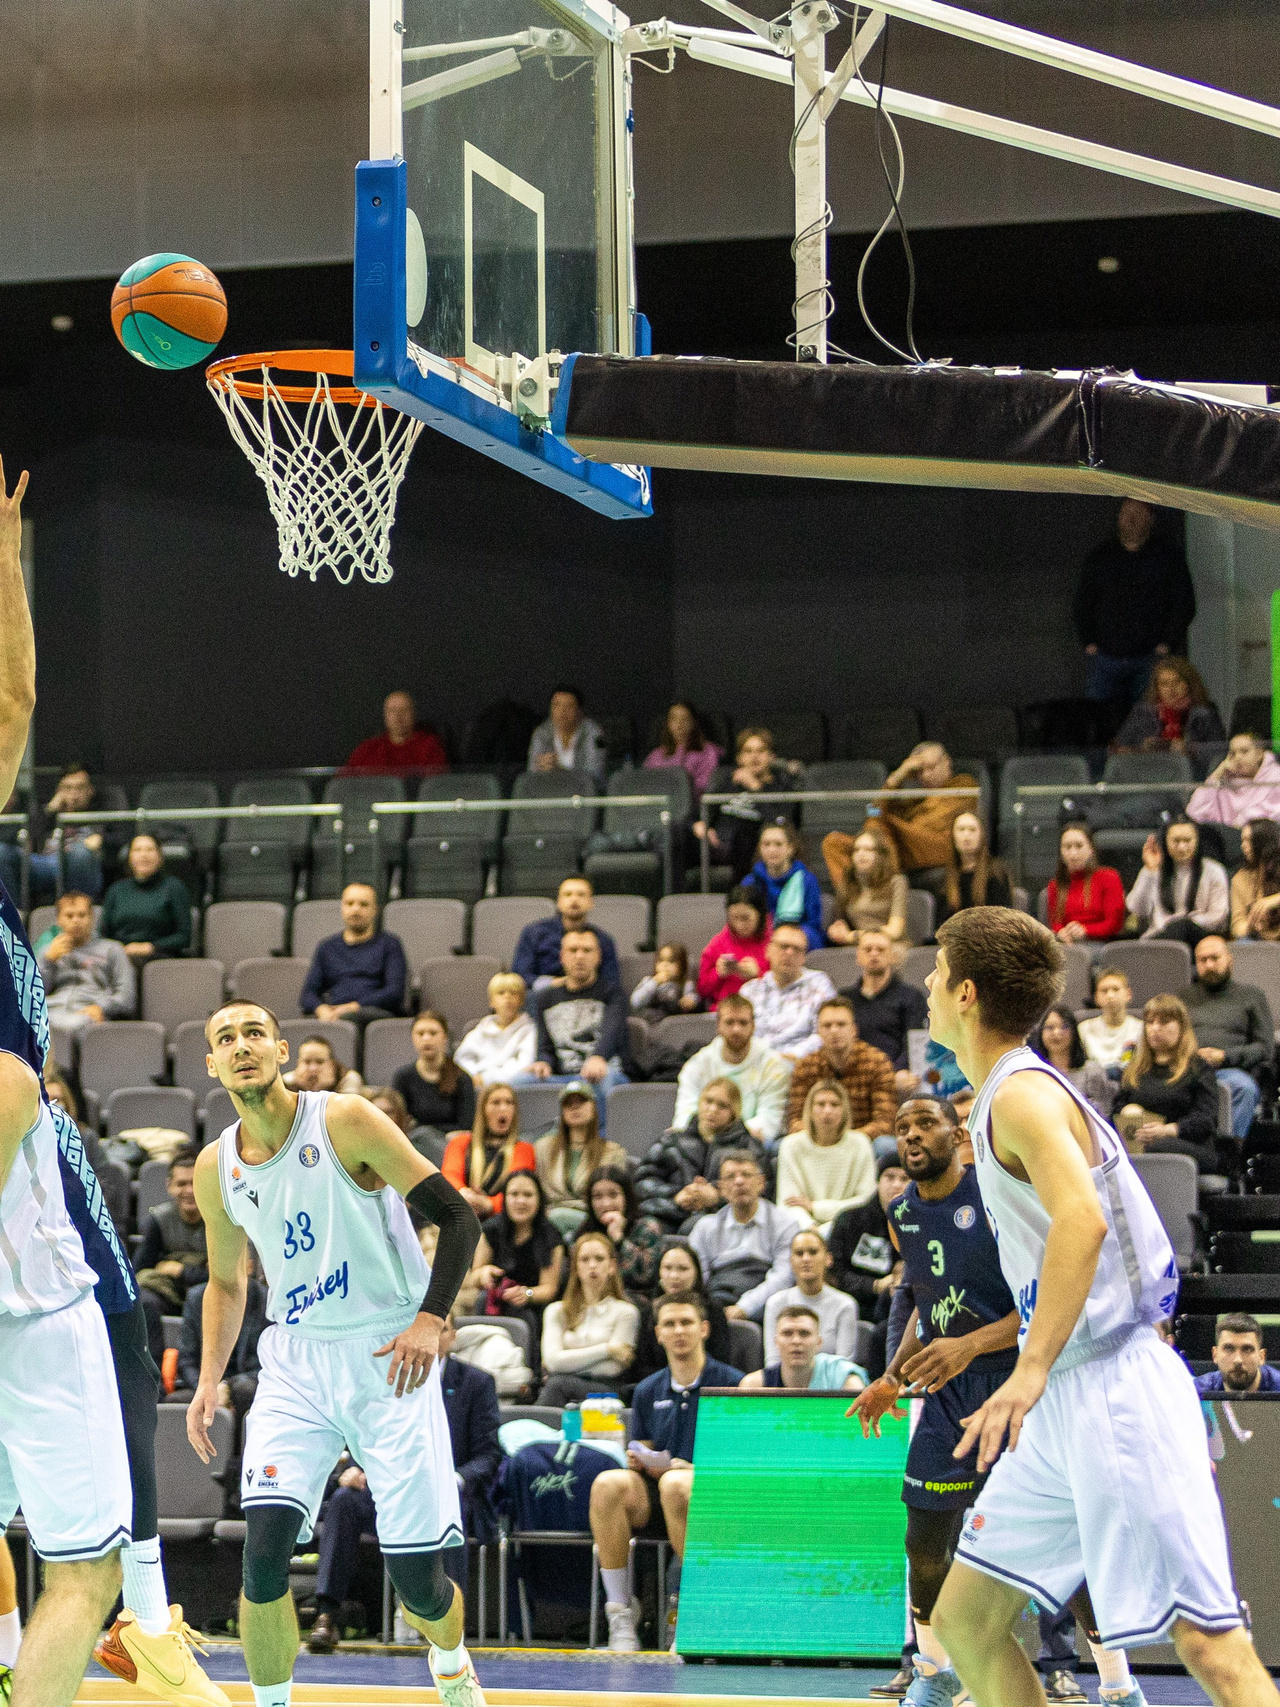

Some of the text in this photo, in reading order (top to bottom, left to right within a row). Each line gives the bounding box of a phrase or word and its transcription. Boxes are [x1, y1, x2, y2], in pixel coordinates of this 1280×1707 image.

[284, 1211, 316, 1259] 33
[927, 1239, 944, 1276] 3
[924, 1480, 975, 1495] евроопт
